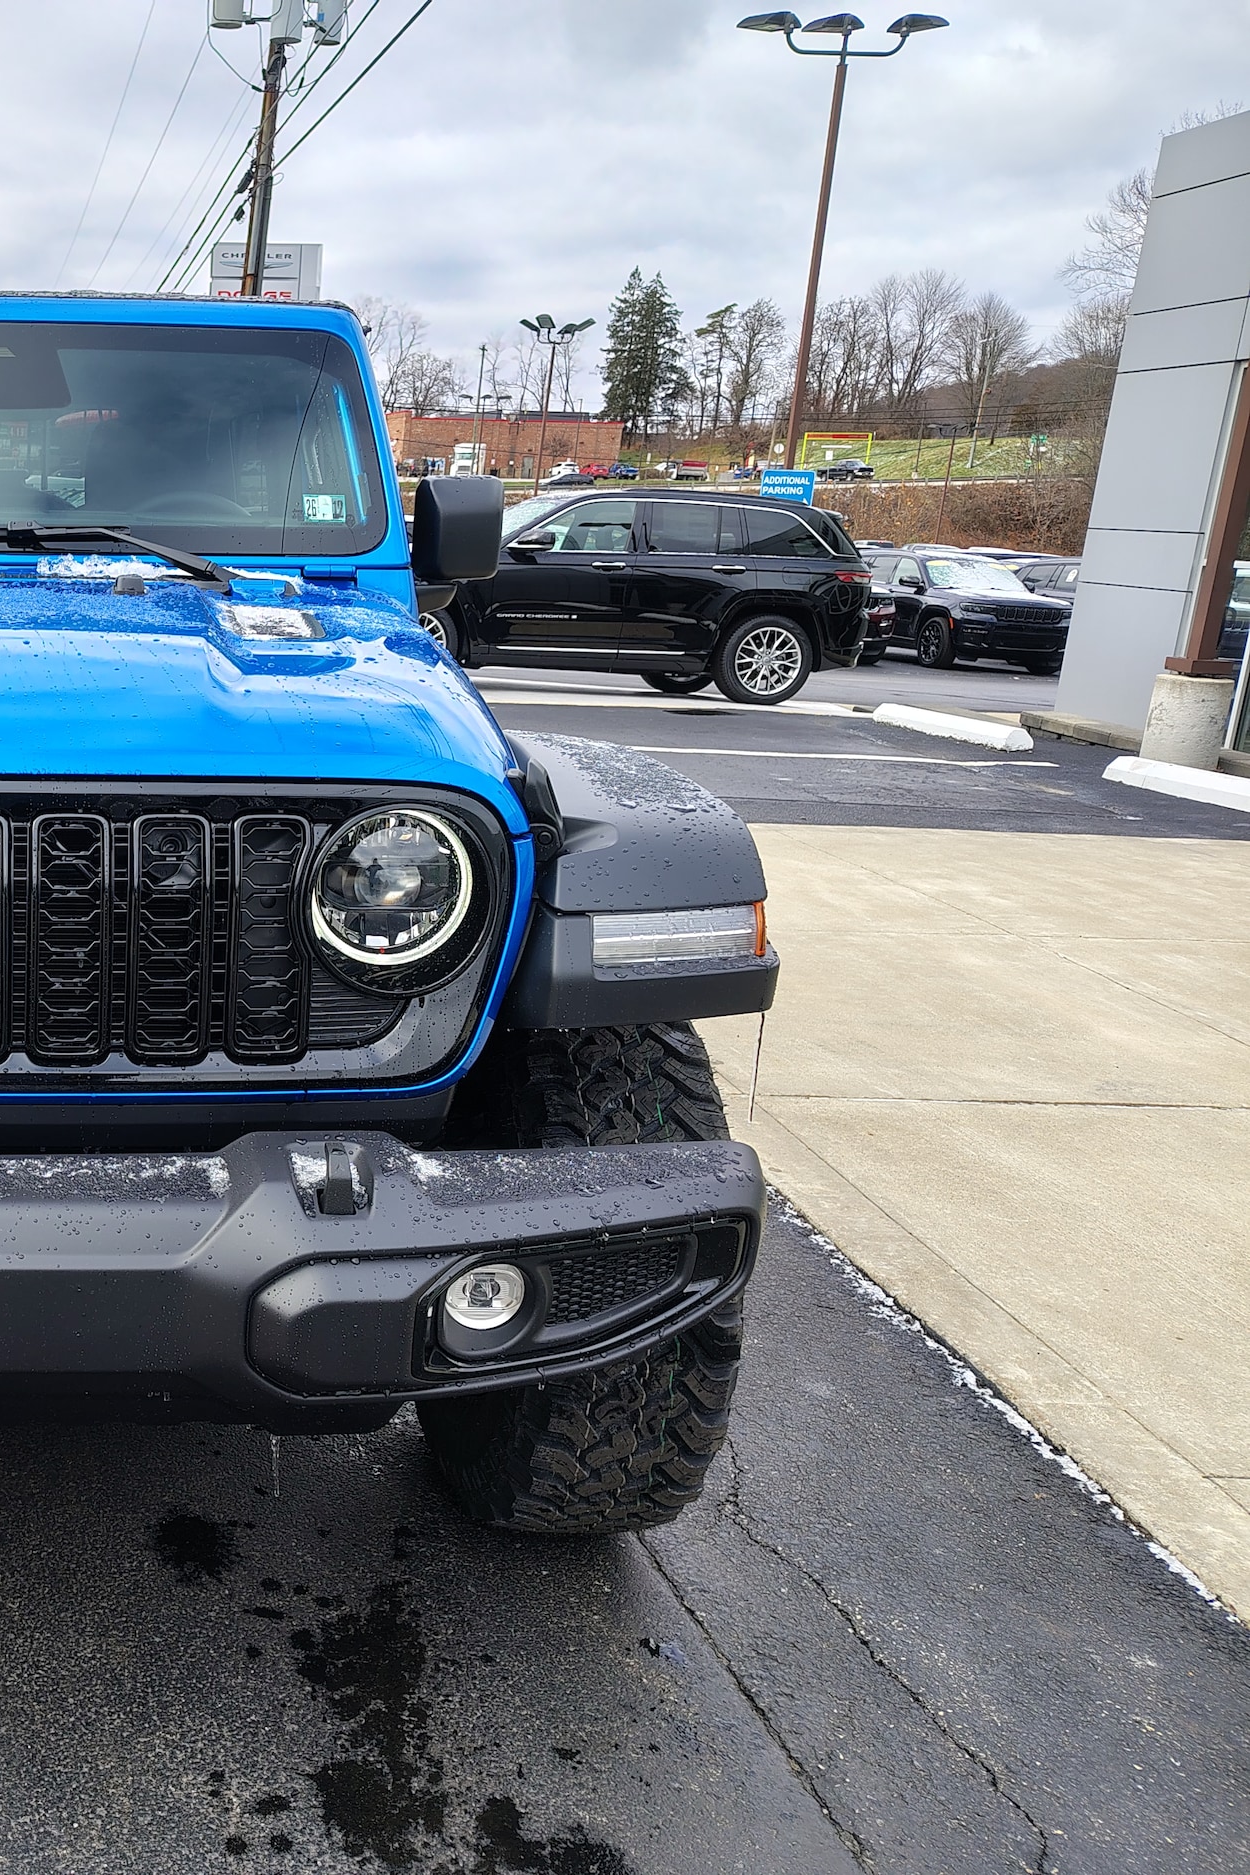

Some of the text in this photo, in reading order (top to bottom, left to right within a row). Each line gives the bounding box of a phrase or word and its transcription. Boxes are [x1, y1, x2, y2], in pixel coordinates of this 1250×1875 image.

[217, 290, 292, 299] DGE
[763, 476, 811, 485] ADDITIONAL
[762, 486, 804, 495] PARKING
[306, 498, 317, 517] 26
[332, 499, 344, 519] 12
